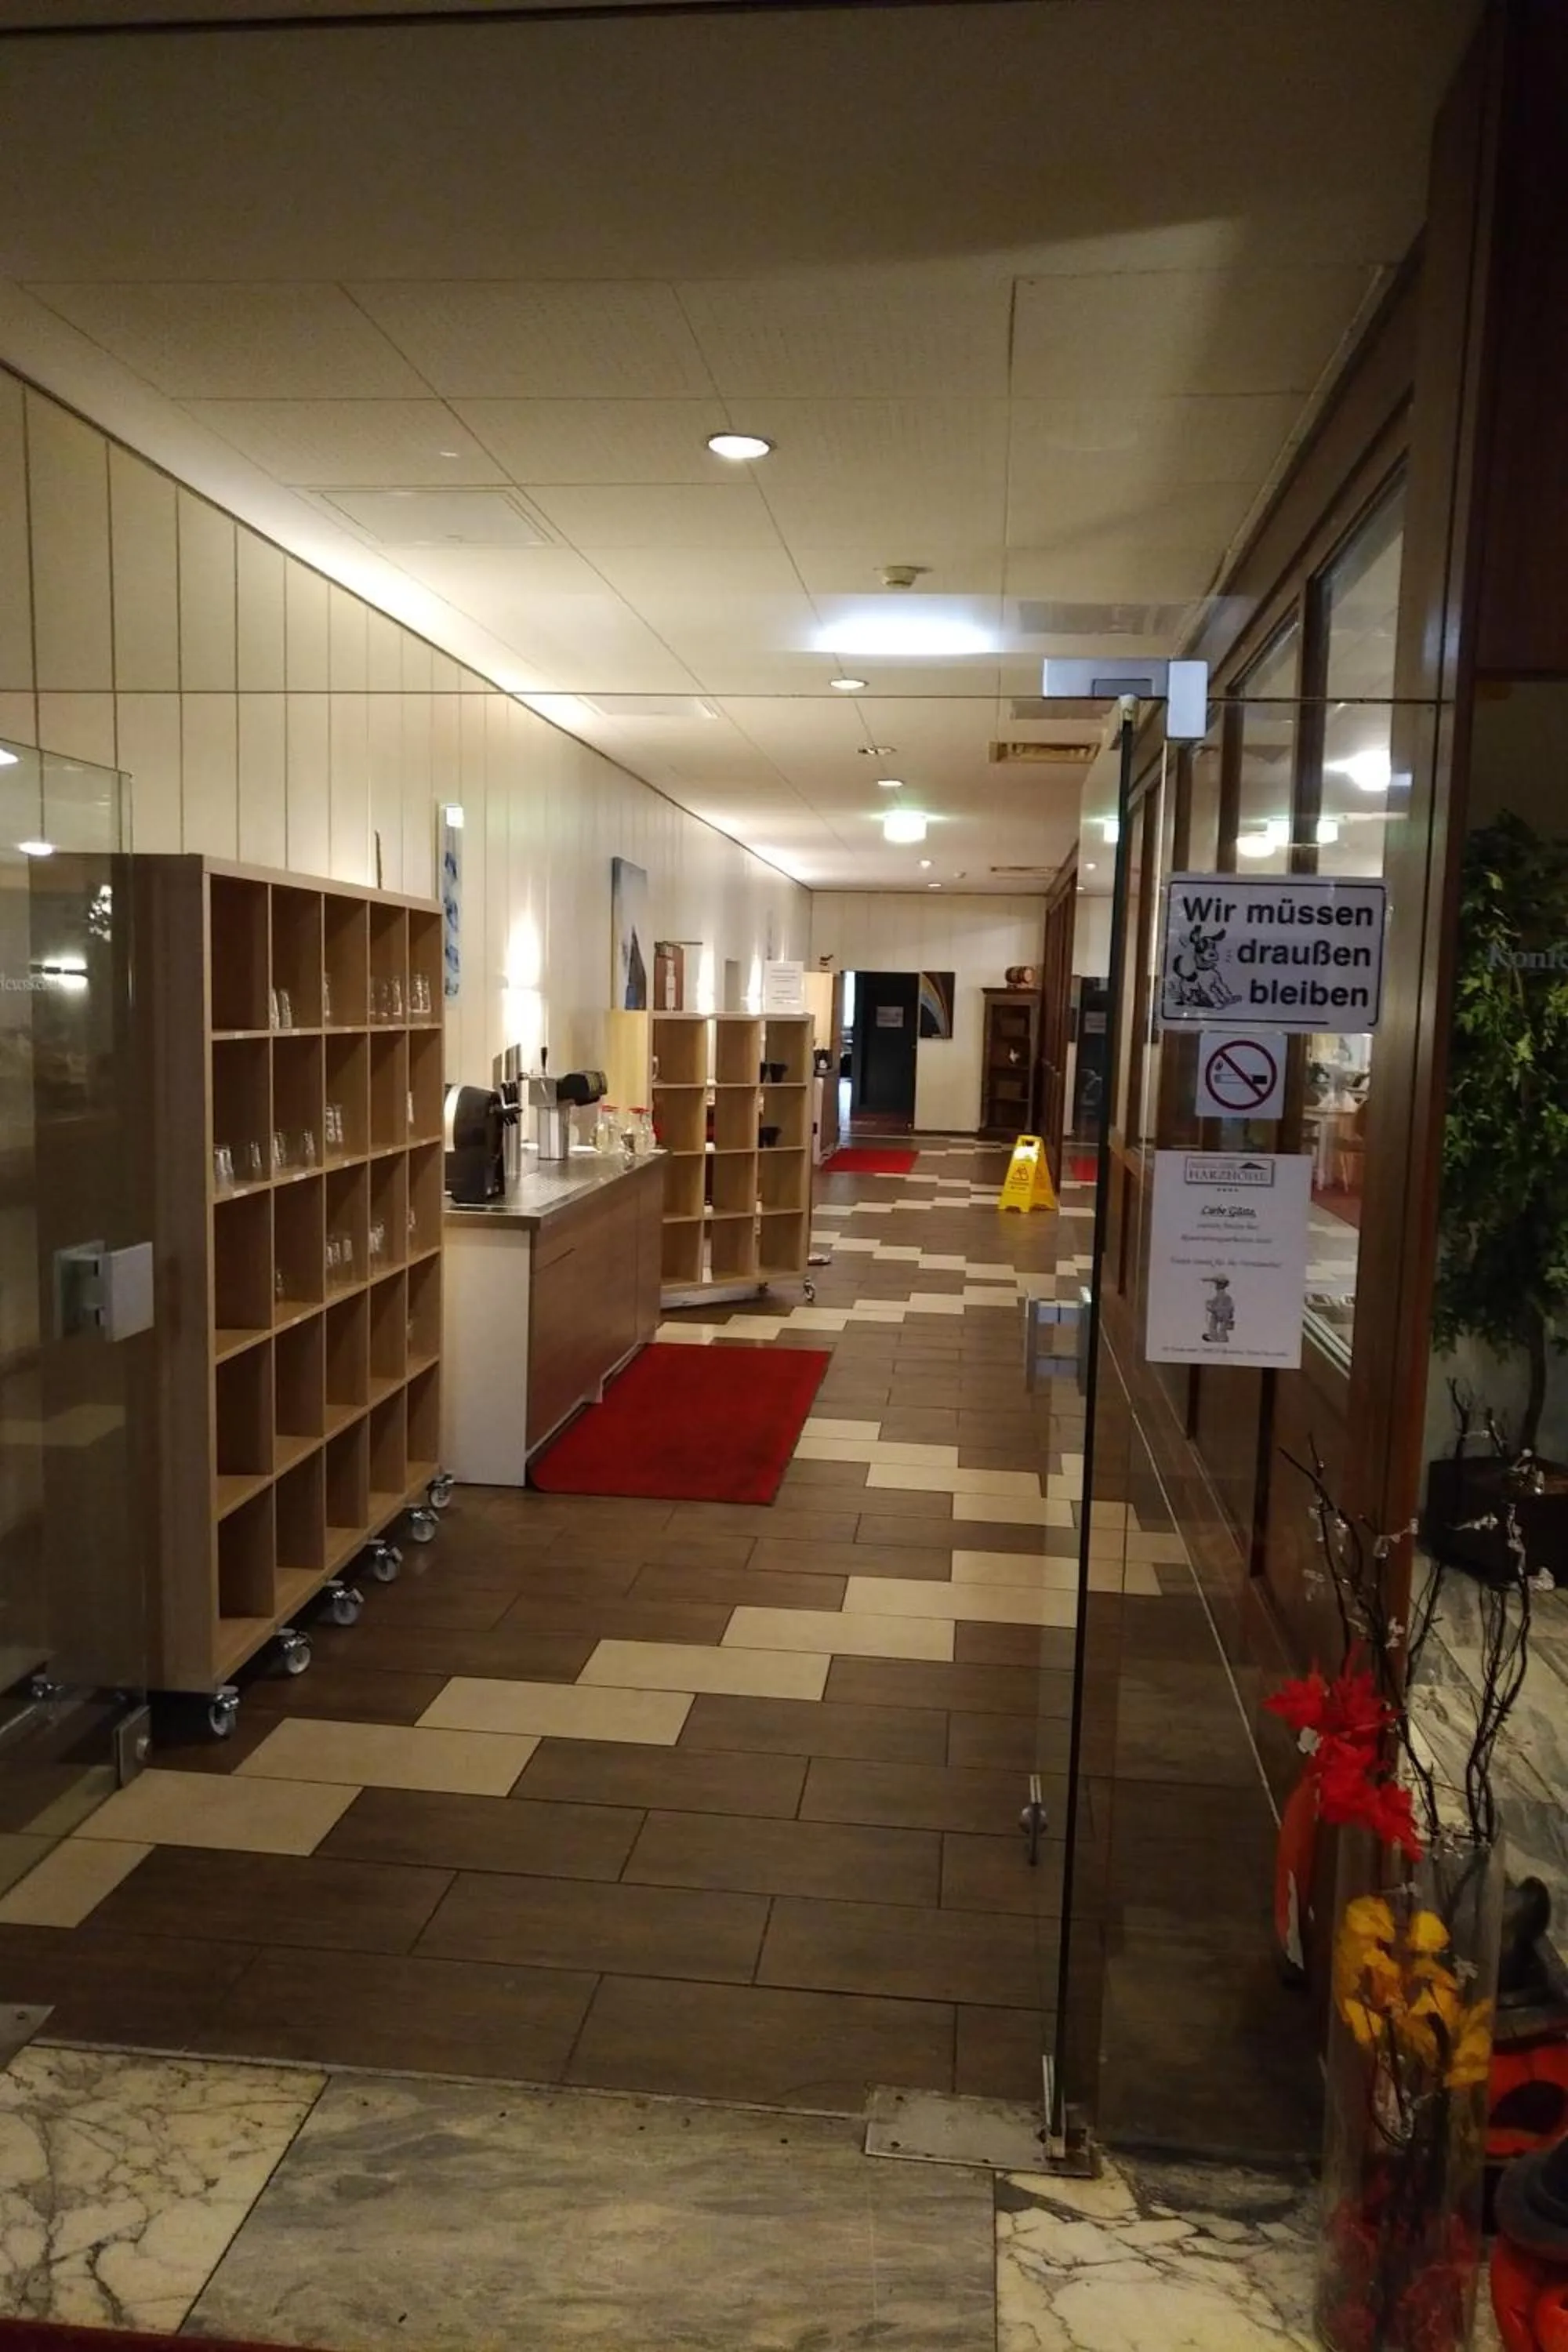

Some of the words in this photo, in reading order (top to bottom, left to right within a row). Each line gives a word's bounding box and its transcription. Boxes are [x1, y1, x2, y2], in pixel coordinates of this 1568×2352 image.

[1182, 896, 1236, 923] Wir
[1247, 898, 1374, 927] müssen
[1236, 938, 1371, 967] draußen
[1249, 979, 1369, 1007] bleiben
